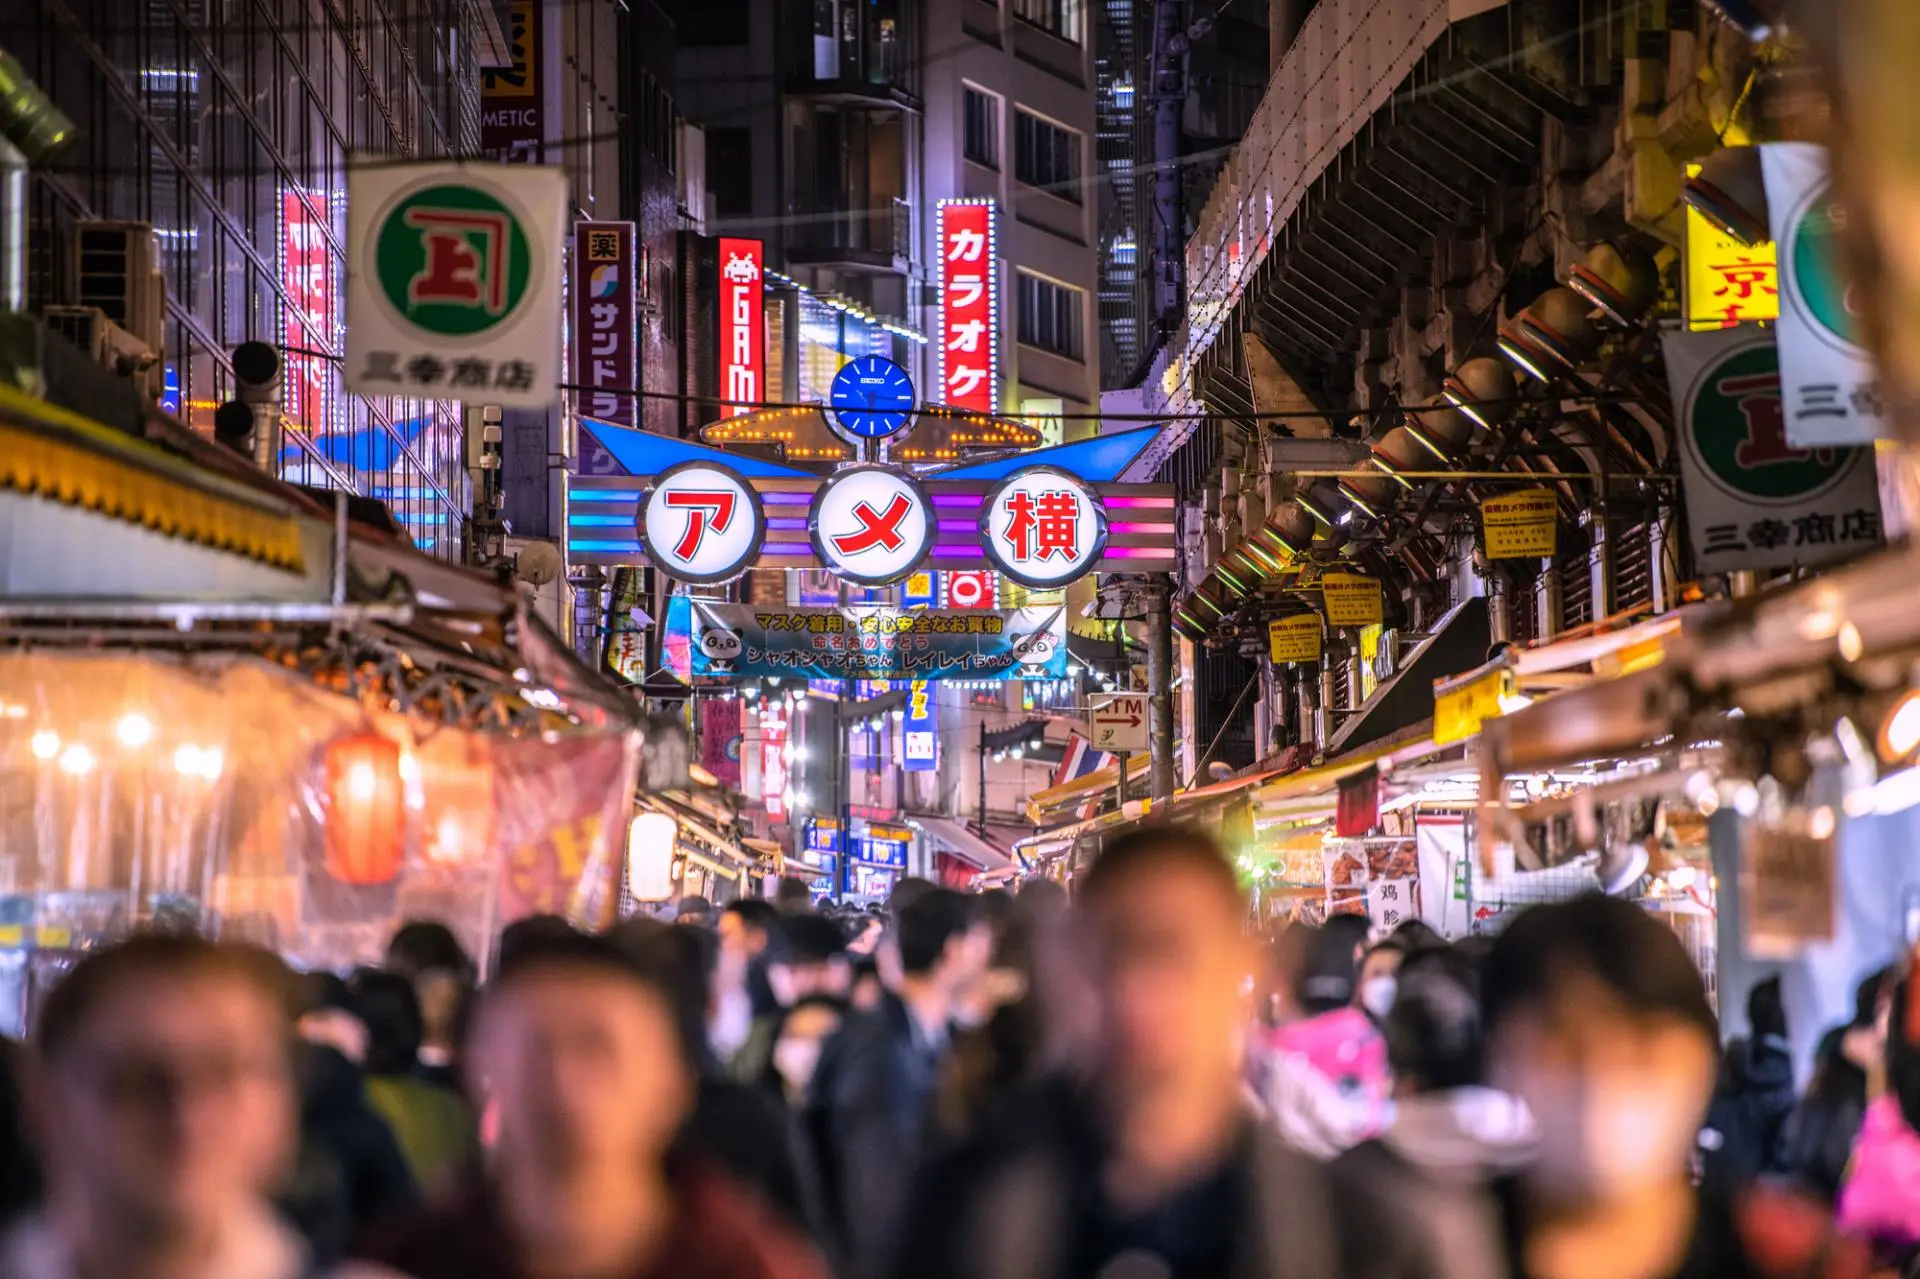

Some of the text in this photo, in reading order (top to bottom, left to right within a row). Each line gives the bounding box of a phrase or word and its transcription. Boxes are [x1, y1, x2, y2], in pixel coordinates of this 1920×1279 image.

[592, 234, 617, 258] 薬
[947, 229, 987, 397] カラオケ
[664, 489, 1081, 562] アメ横
[1703, 509, 1879, 555] 三幸商店
[755, 613, 1003, 634] マスク着用・安心安全なお買物
[812, 635, 930, 650] 命名おめでとう
[746, 647, 1013, 670] シャオシャオちゃん レイレイちゃん
[1095, 698, 1142, 714] TM
